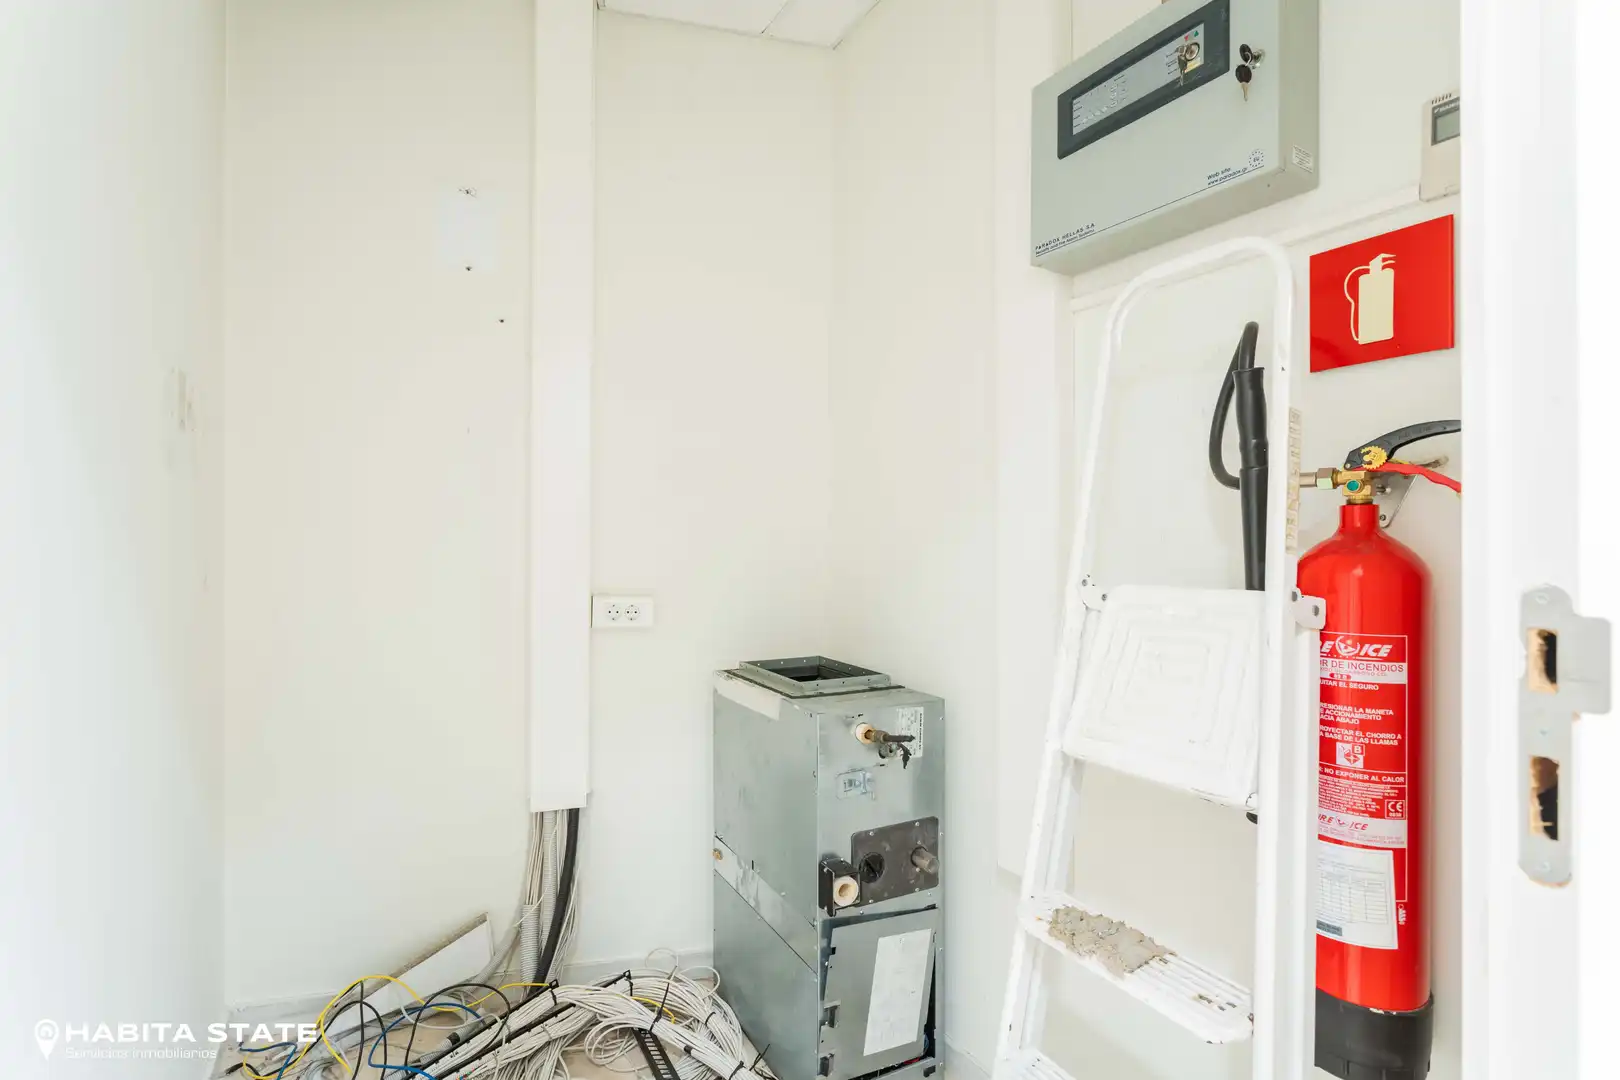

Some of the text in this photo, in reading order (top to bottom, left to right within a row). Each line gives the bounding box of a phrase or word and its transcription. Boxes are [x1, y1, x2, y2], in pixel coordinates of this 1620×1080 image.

[1035, 237, 1060, 250] PARADOX
[1062, 227, 1084, 240] HELLAS
[1360, 644, 1393, 657] ICE
[1331, 660, 1345, 669] DE
[1347, 661, 1404, 673] INCENDIOS
[1338, 681, 1348, 689] EL
[1348, 682, 1379, 691] SEGURO
[1319, 702, 1394, 716] RESIONAR LA MANETA
[1325, 710, 1382, 721] ACCIONAMIENTO
[1335, 716, 1360, 725] ABAJO
[1319, 725, 1354, 735] ROYECTAR
[1355, 730, 1365, 738] EL
[1365, 731, 1396, 740] CHORRO
[1324, 732, 1343, 741] BASE
[1370, 738, 1399, 746] LLAMAS
[1354, 746, 1362, 754] B
[1324, 767, 1335, 775] NO
[1335, 771, 1370, 780] EXPONER
[1349, 822, 1369, 831] ICE
